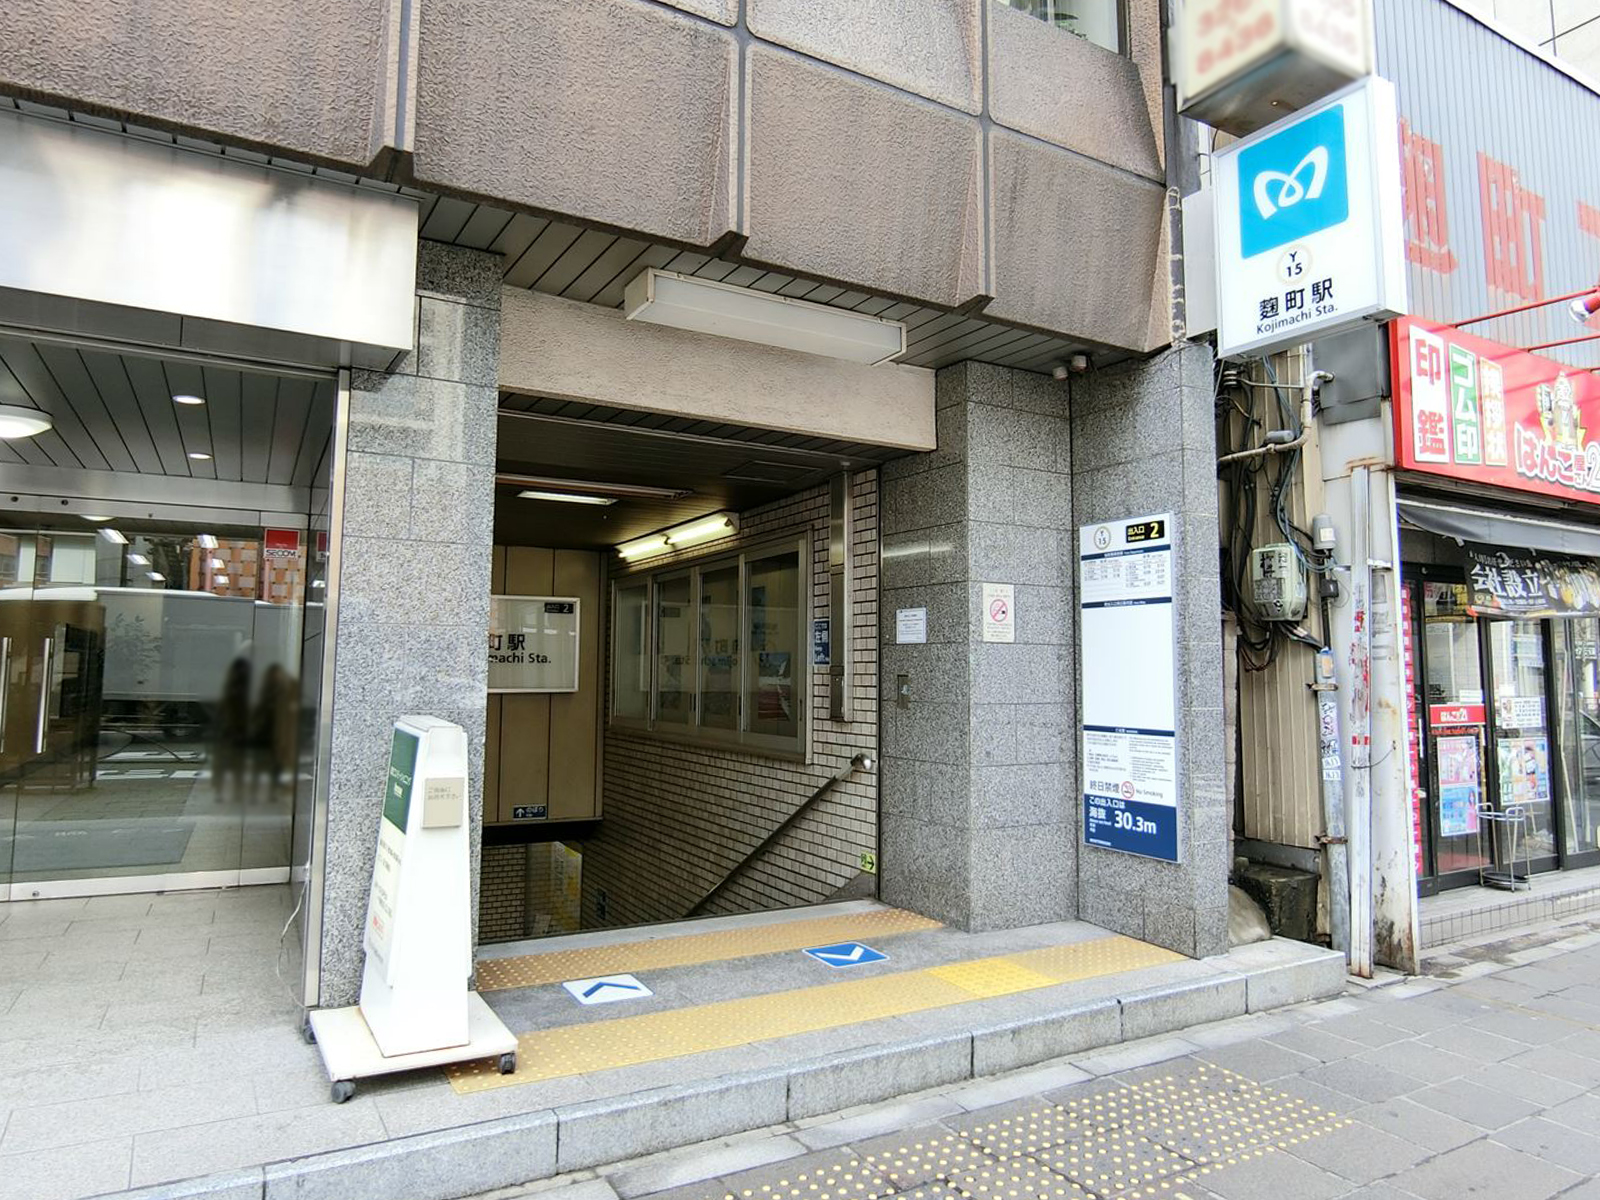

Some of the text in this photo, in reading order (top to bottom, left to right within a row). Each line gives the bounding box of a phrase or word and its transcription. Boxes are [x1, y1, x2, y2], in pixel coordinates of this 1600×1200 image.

[1289, 251, 1298, 263] Y
[1286, 262, 1303, 277] 15
[1256, 304, 1338, 335] Kojimachi Sta.
[1149, 522, 1160, 538] 2
[1098, 537, 1107, 545] 15
[1470, 563, 1543, 598] 会社設立
[528, 653, 551, 663] Sta.
[1142, 788, 1163, 799] Smoking
[1114, 810, 1157, 835] 30.3m
